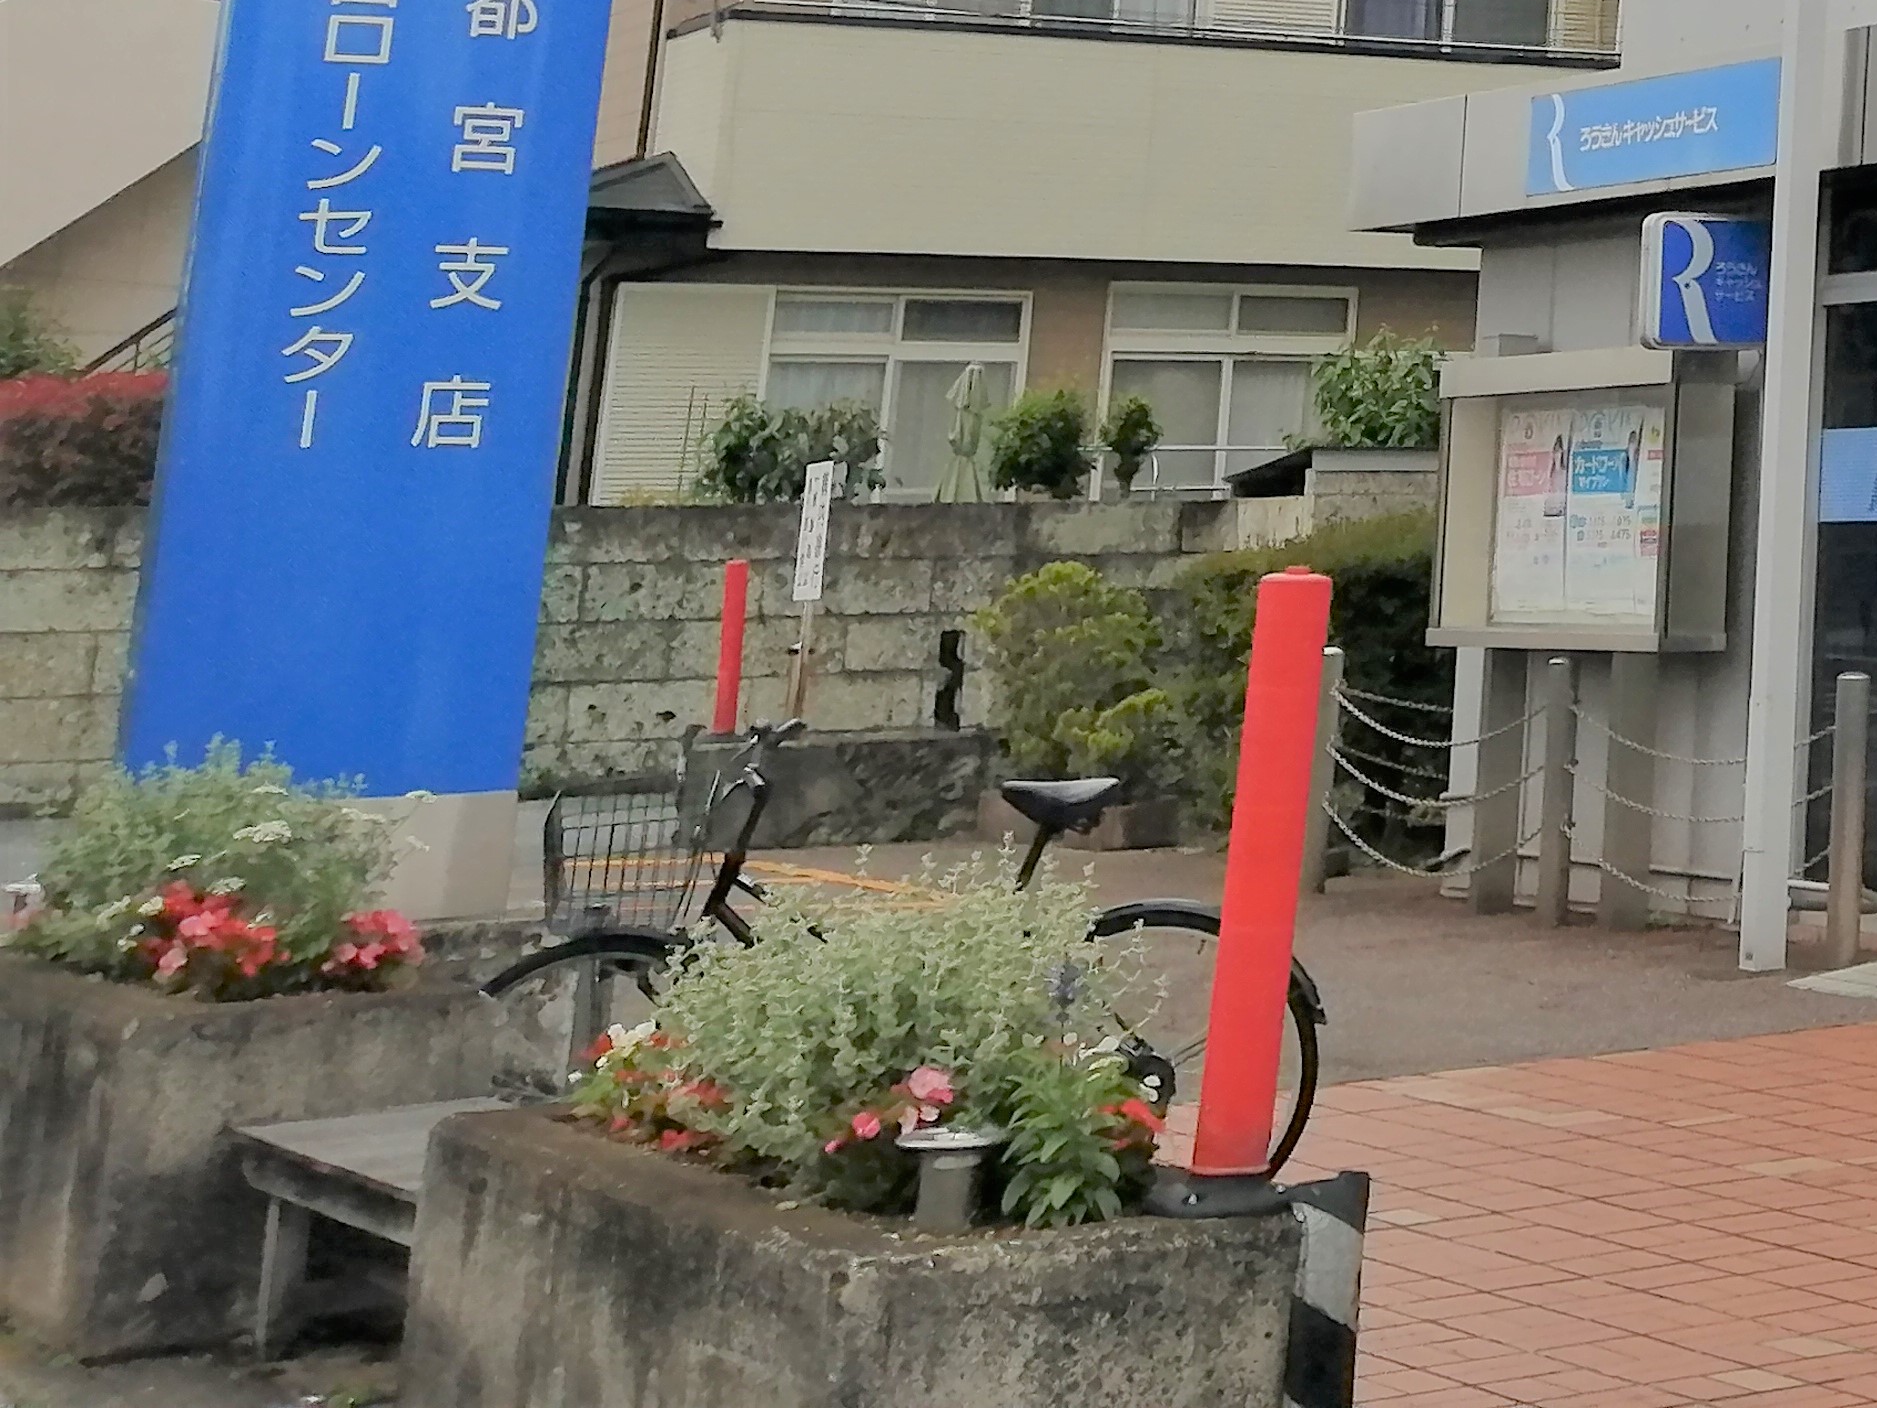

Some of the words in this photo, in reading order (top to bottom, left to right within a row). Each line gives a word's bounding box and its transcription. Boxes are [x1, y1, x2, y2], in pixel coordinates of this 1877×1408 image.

[1578, 106, 1719, 153] ろうきんキャッシュサービス
